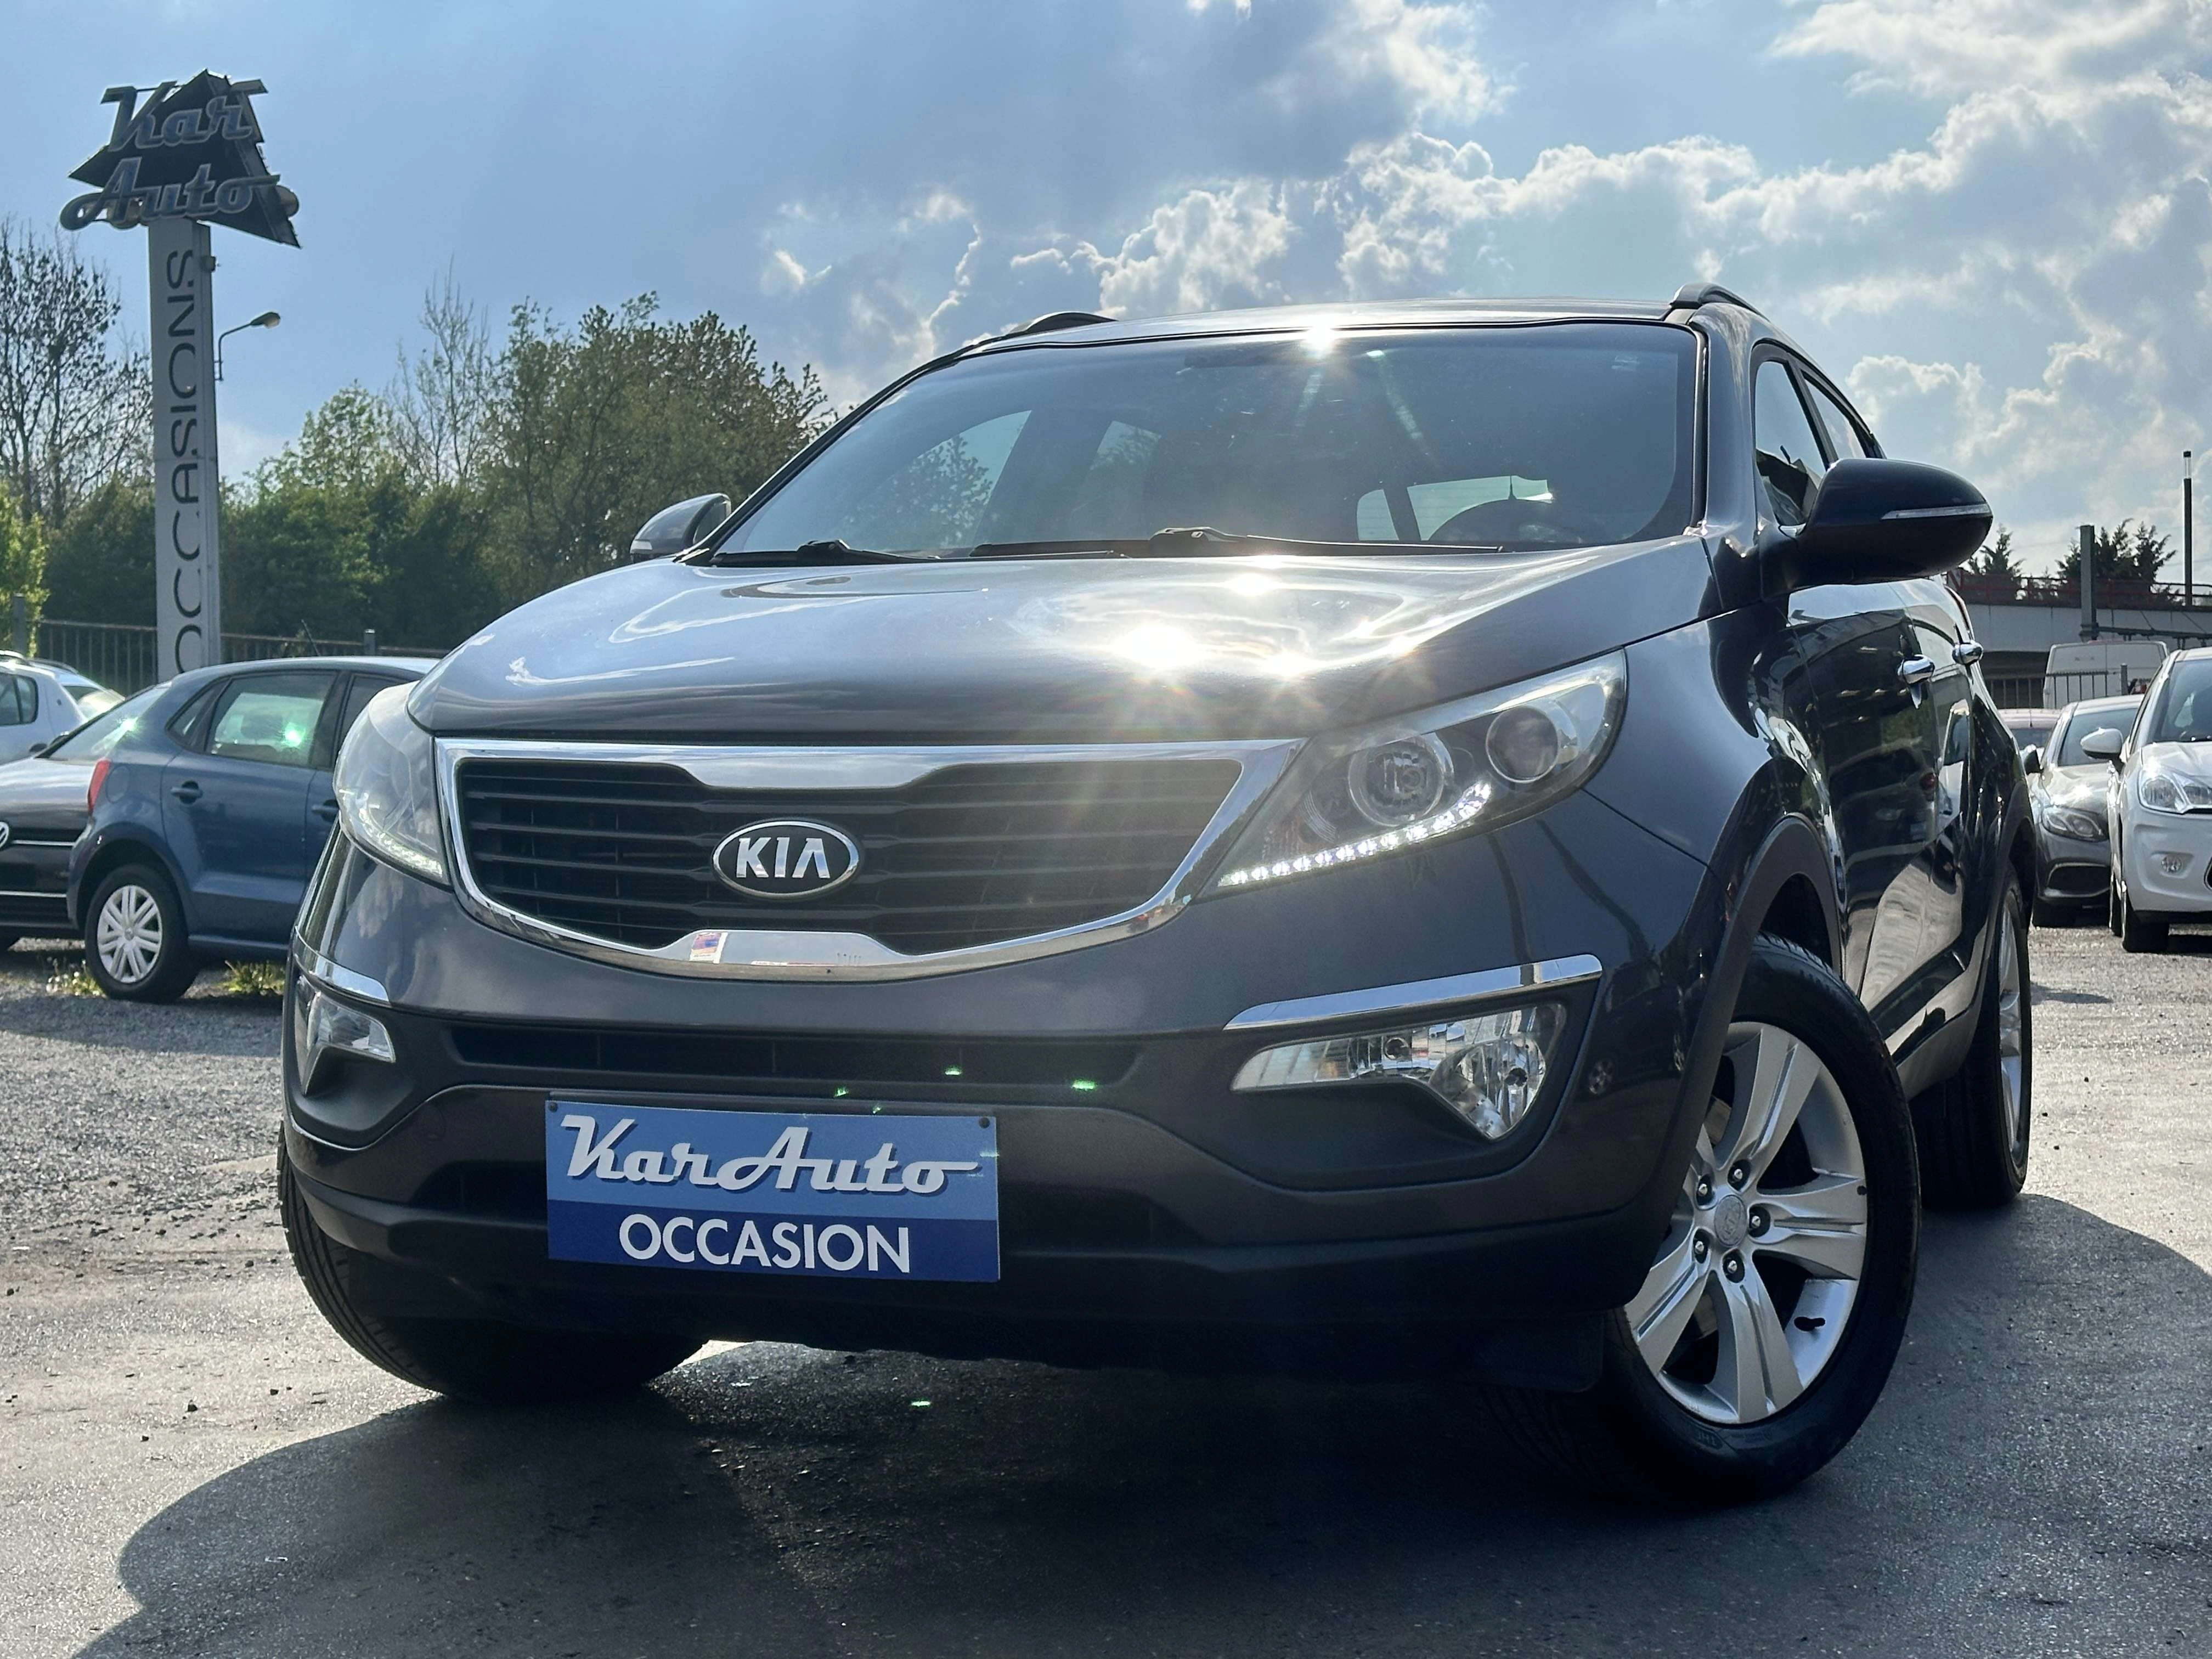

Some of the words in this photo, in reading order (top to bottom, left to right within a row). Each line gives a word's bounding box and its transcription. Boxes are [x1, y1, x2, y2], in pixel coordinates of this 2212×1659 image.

[101, 81, 255, 151] Kar
[60, 156, 280, 230] Auto
[166, 249, 202, 674] OCCASIONS
[736, 837, 831, 878] KIA
[618, 1213, 911, 1274] OCCASION
